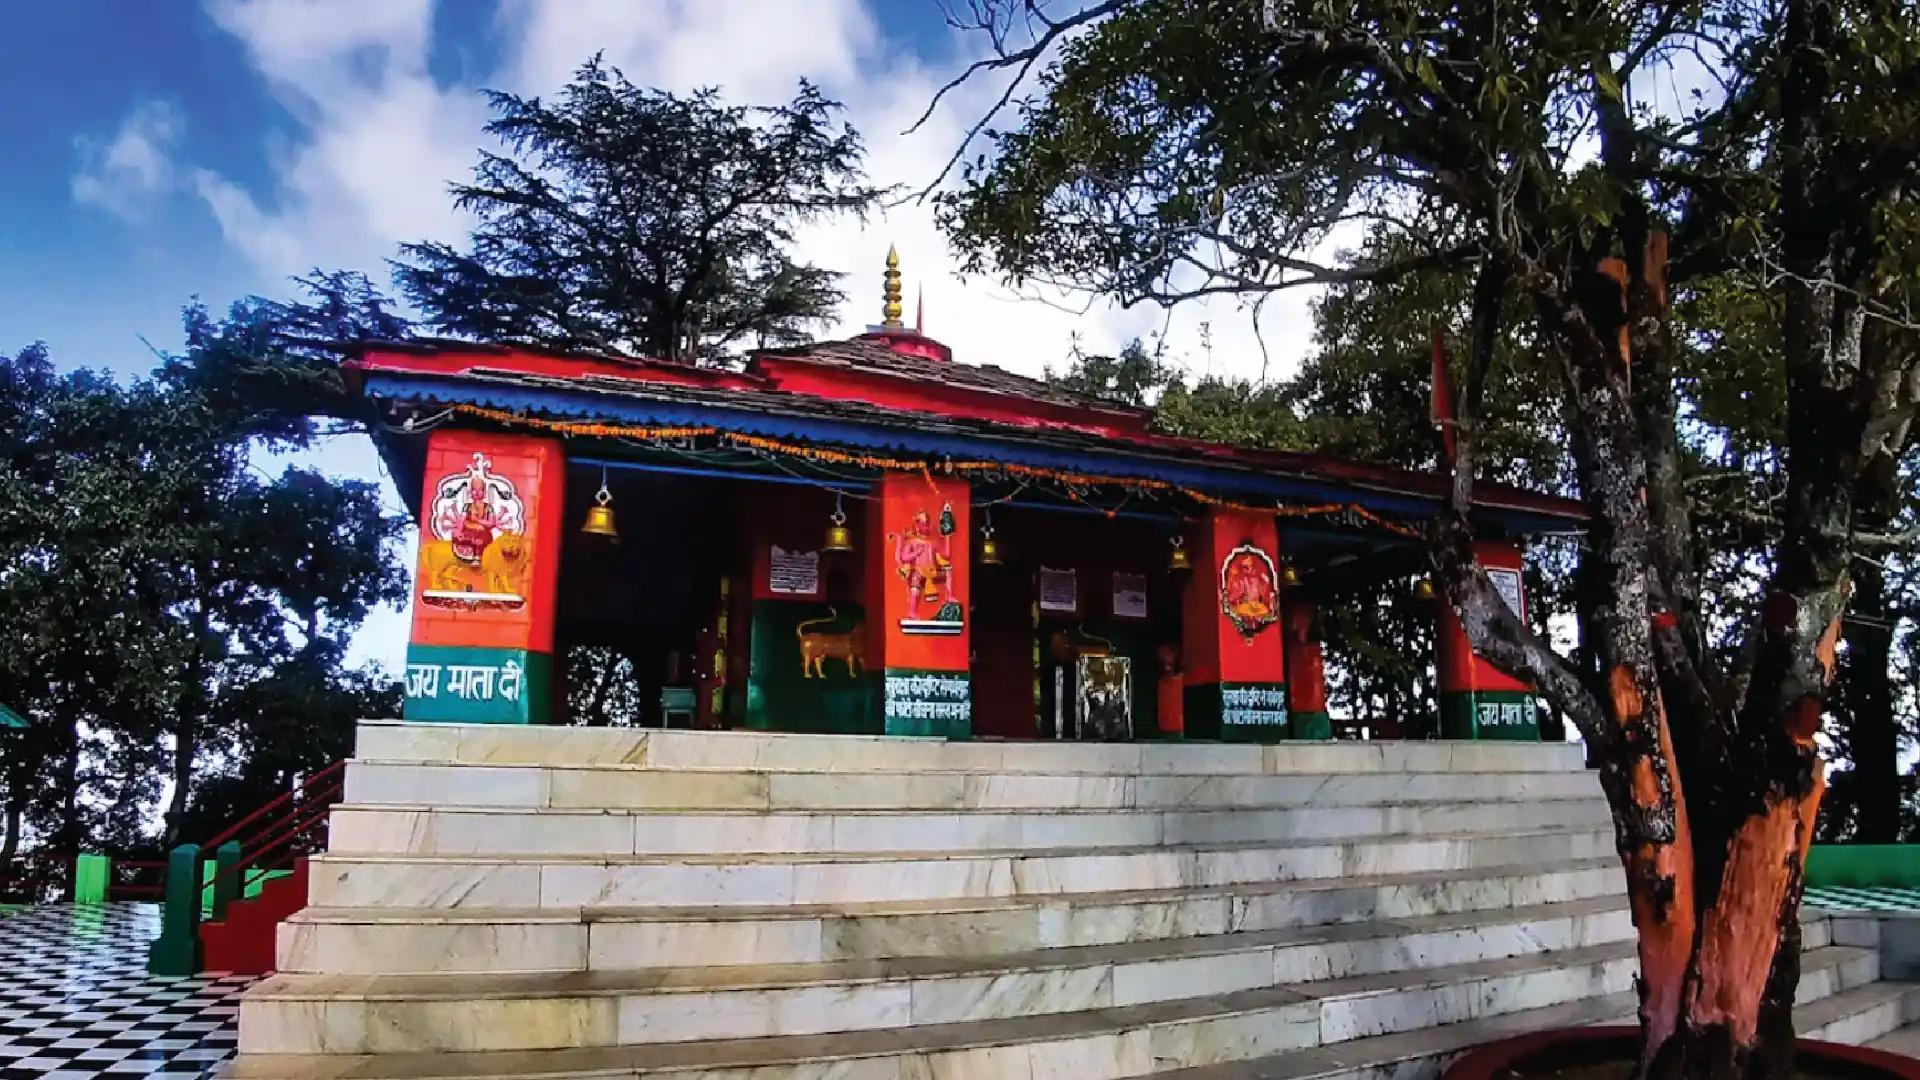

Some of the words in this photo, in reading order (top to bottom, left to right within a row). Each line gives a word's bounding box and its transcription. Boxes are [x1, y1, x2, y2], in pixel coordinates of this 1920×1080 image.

[405, 664, 441, 698] जय
[447, 665, 498, 699] माता
[498, 659, 523, 701] दी
[1478, 702, 1499, 726] जय
[1501, 703, 1522, 725] माता
